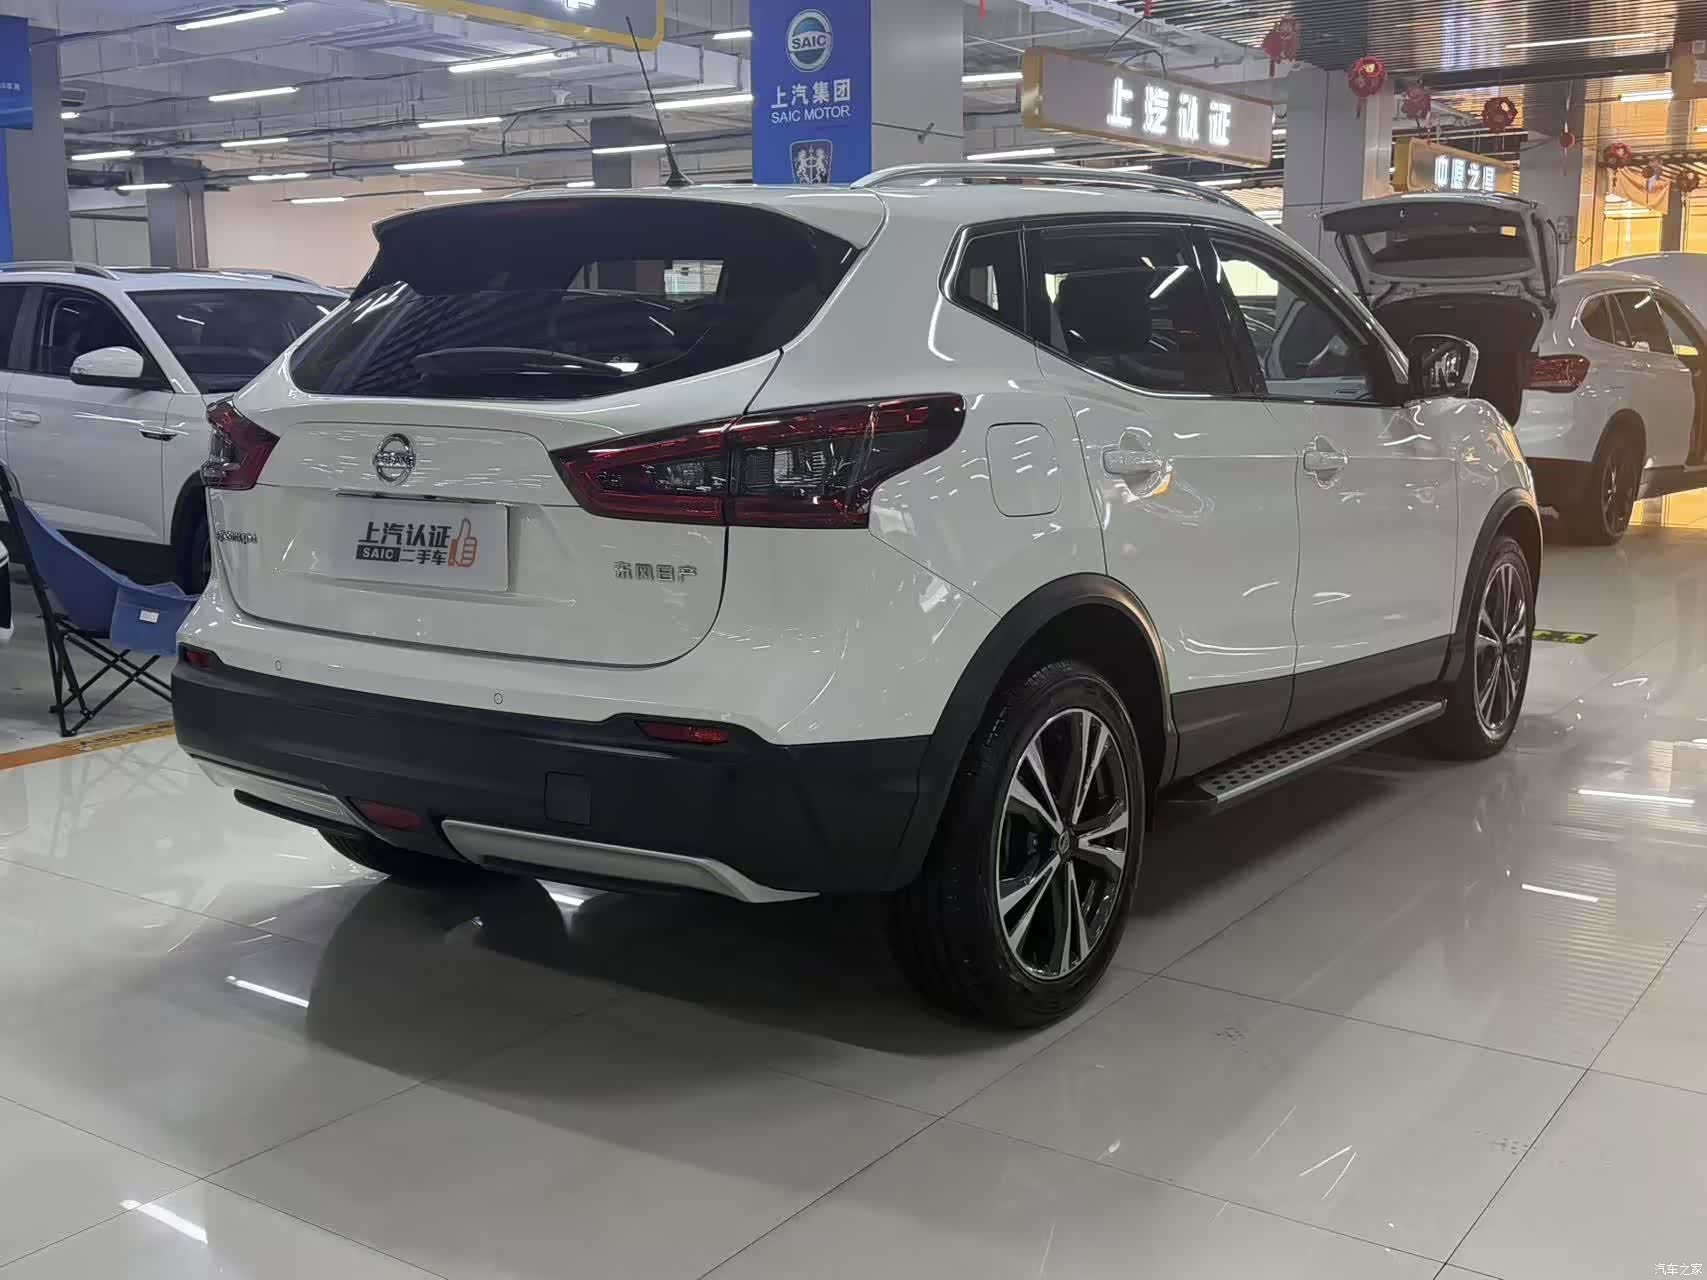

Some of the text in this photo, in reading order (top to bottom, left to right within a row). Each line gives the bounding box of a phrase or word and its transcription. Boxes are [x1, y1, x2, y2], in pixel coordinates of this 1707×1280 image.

[791, 34, 827, 50] SAIC
[771, 78, 851, 108] 上汽集团
[771, 105, 851, 124] SAIC MOTOR
[1106, 76, 1232, 146] 上汽认证
[358, 521, 452, 549] 上汽认证
[361, 547, 448, 566] SAIC 二手车
[613, 560, 698, 583] 东风日产
